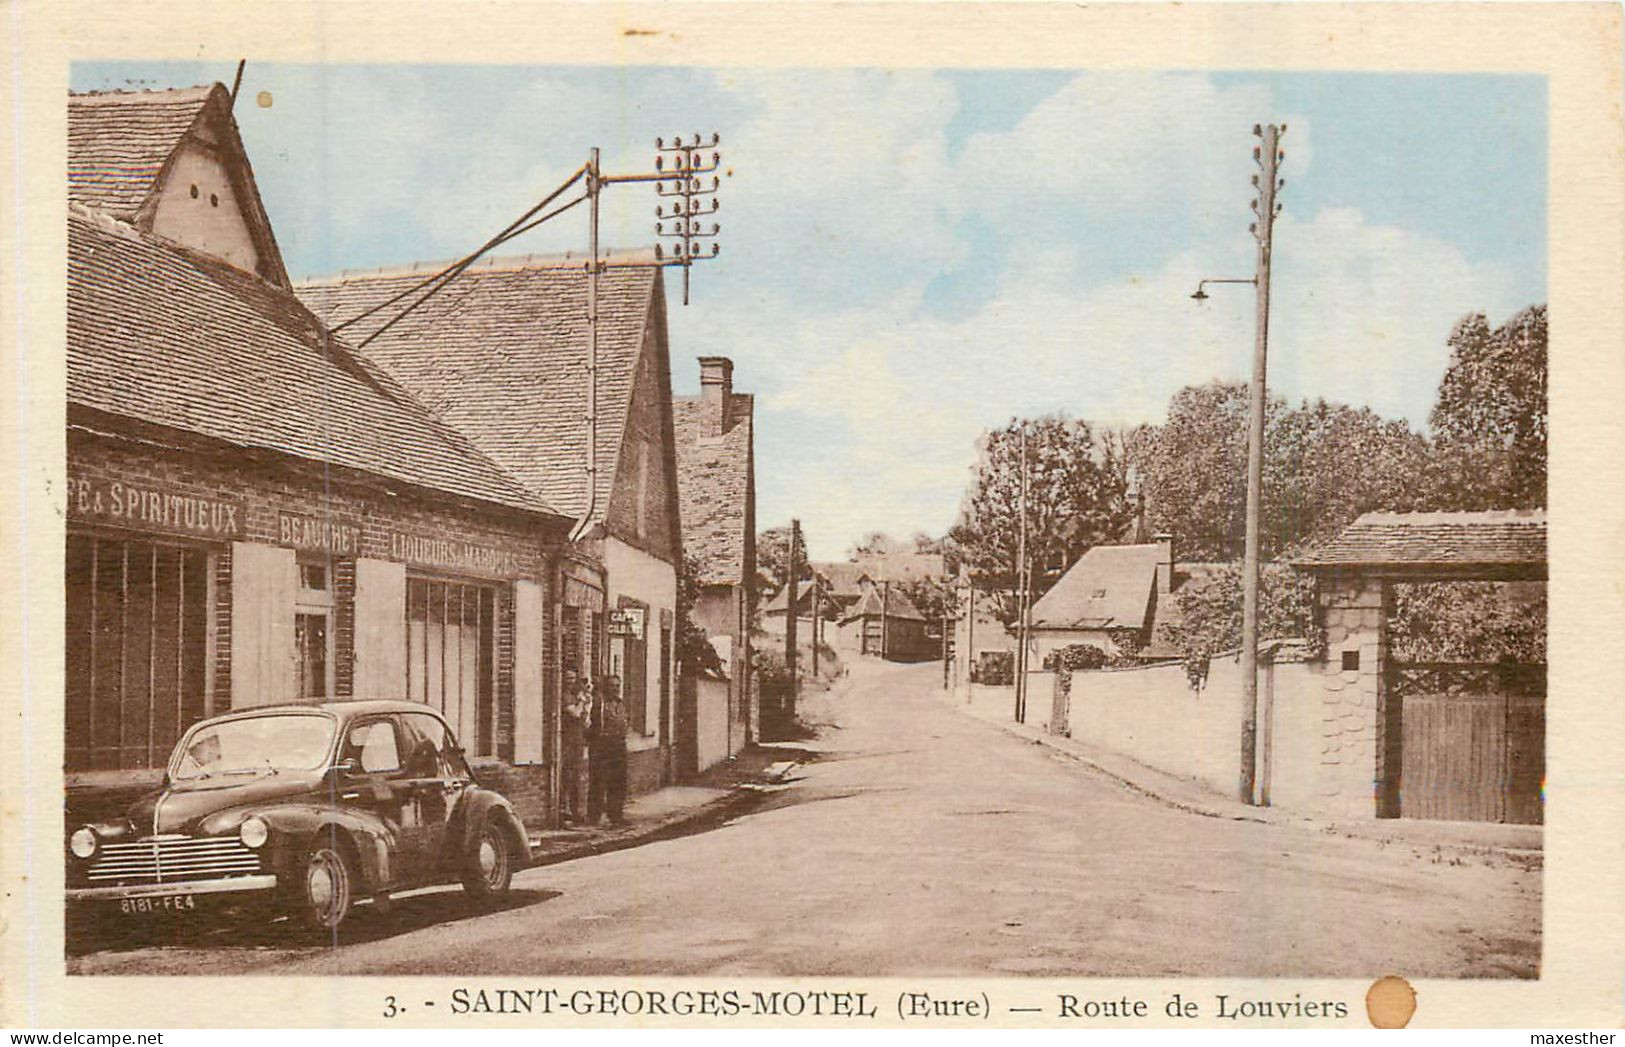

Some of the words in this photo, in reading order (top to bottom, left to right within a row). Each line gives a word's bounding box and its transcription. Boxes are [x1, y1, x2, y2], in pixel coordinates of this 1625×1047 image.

[110, 482, 239, 533] SPIRITUEUX
[280, 515, 361, 554] BEAUCHET
[392, 532, 457, 567] LIQUEURS
